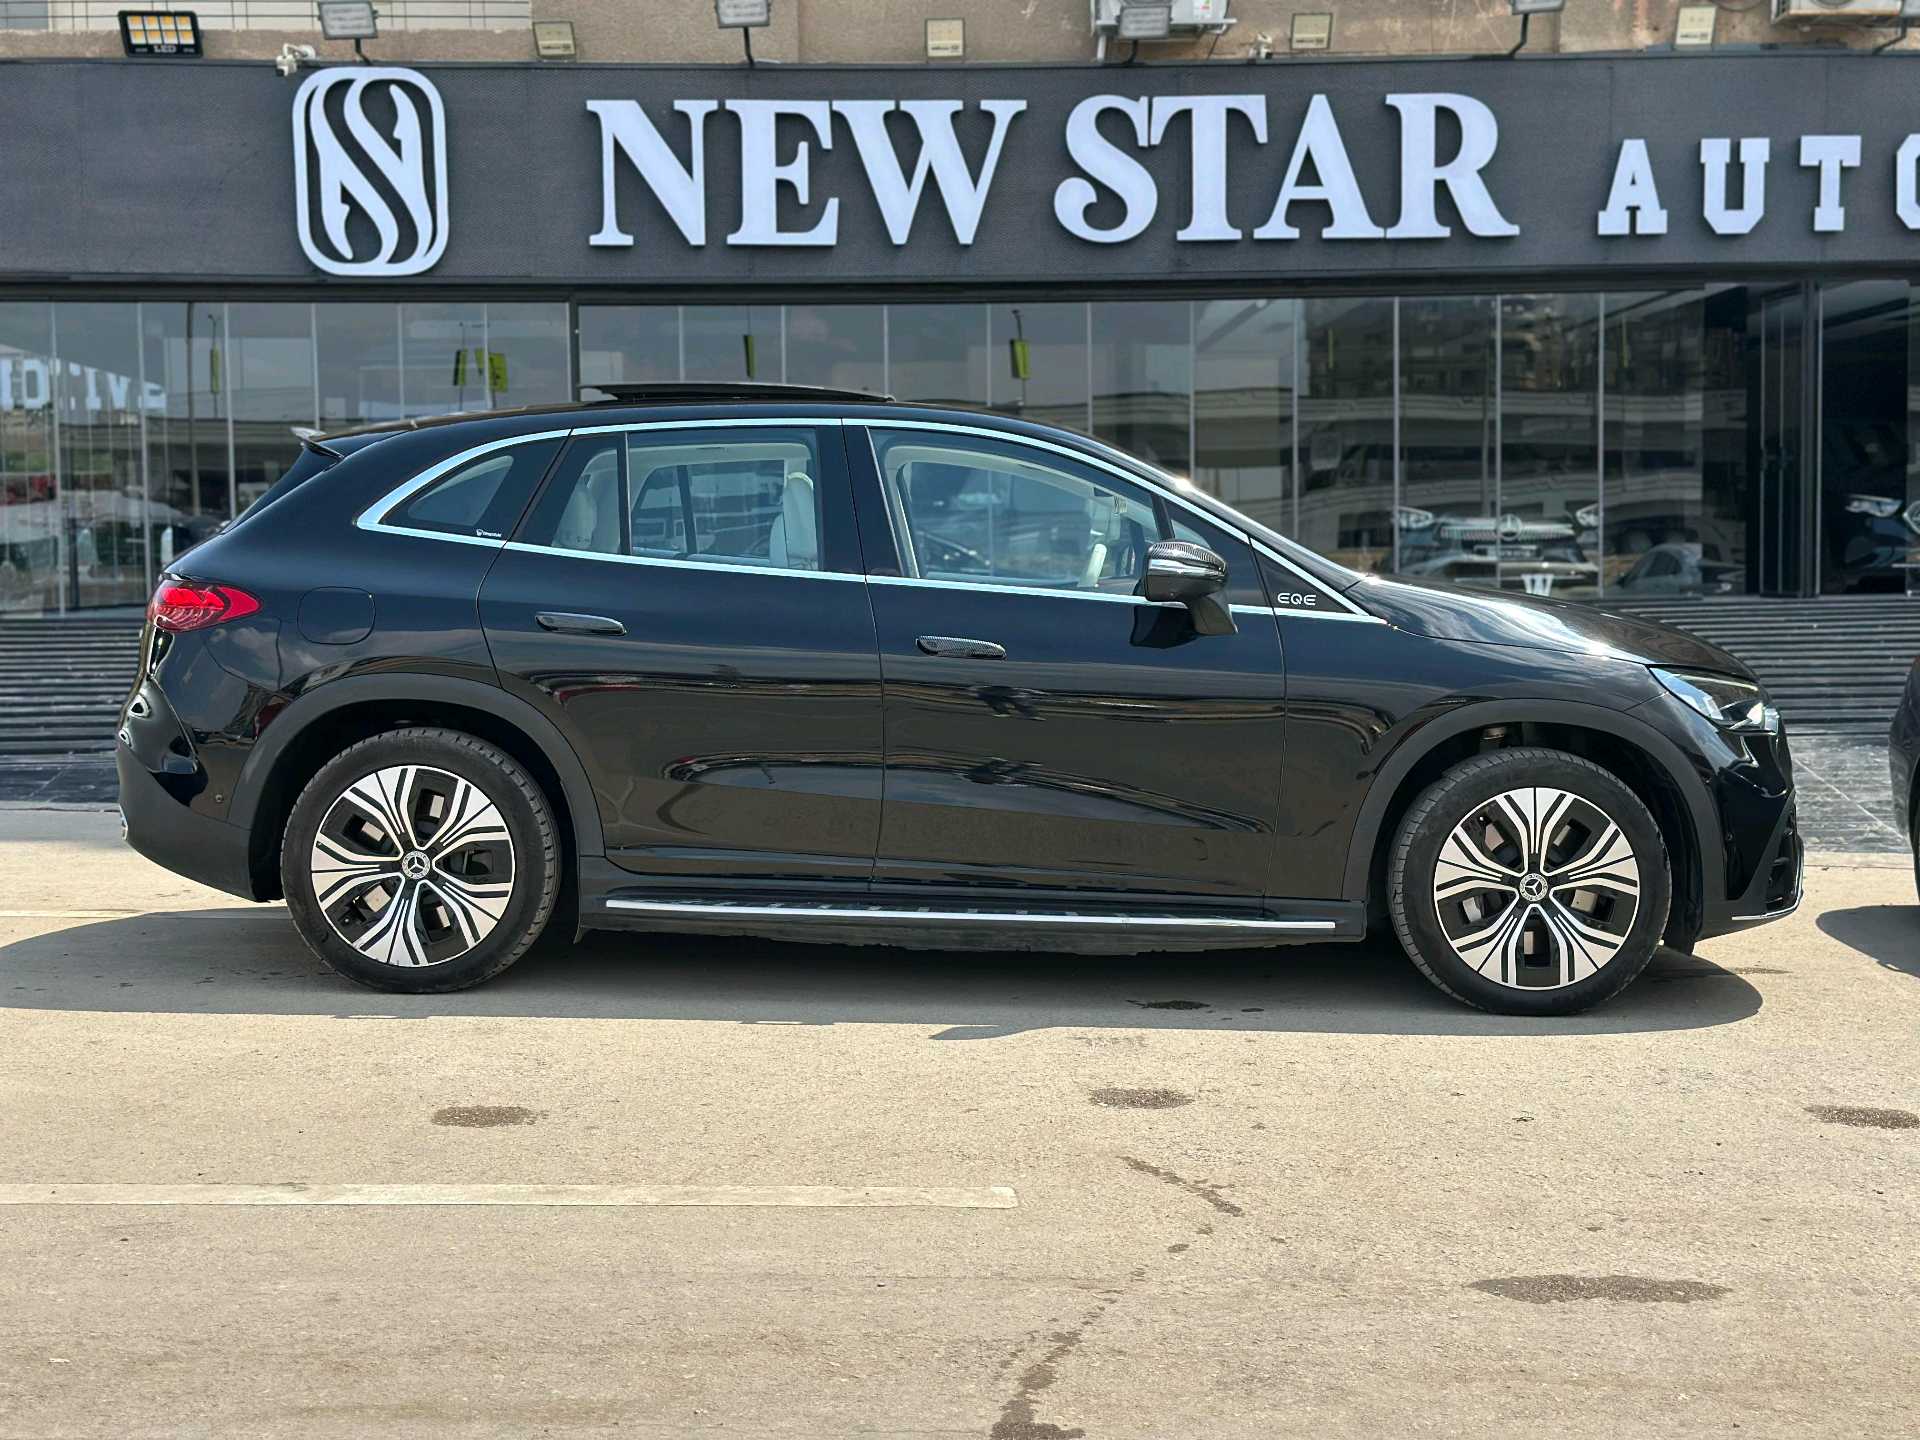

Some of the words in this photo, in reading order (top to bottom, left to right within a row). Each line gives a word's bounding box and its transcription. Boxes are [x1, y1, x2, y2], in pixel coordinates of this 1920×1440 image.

[153, 45, 177, 53] LED
[586, 99, 1027, 246] NEW
[1054, 92, 1520, 243] STAR
[1277, 592, 1317, 606] EQE
